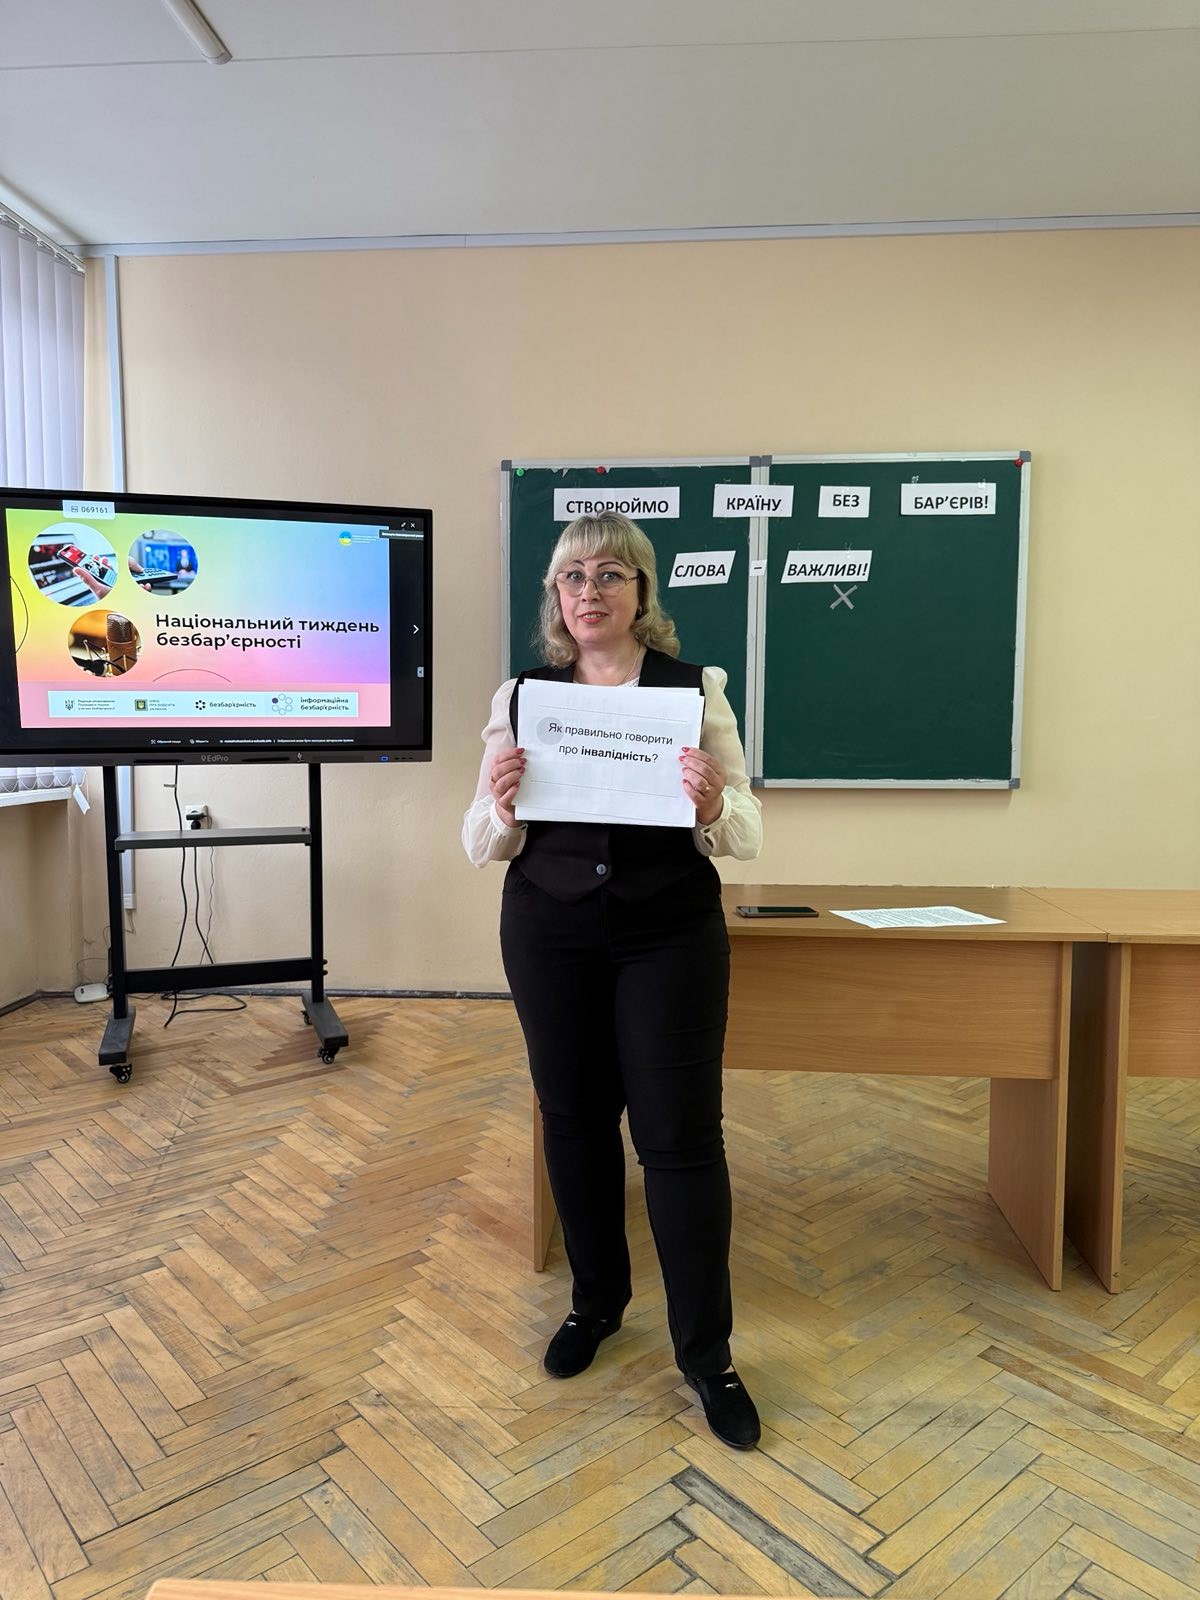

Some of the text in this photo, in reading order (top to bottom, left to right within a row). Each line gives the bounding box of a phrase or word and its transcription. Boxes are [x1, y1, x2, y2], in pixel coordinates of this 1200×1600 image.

[81, 506, 108, 514] 069161
[566, 498, 669, 514] СТВОРЮЙМО
[726, 494, 782, 511] КРАЇНУ
[832, 494, 860, 507] БЕЗ
[674, 564, 726, 578] СЛОВА
[787, 563, 867, 577] ВАЖЛИВІ!
[156, 614, 379, 633] Національний тиждень
[548, 723, 673, 745] Як правильно говорити
[559, 745, 658, 763] про інвалідність?
